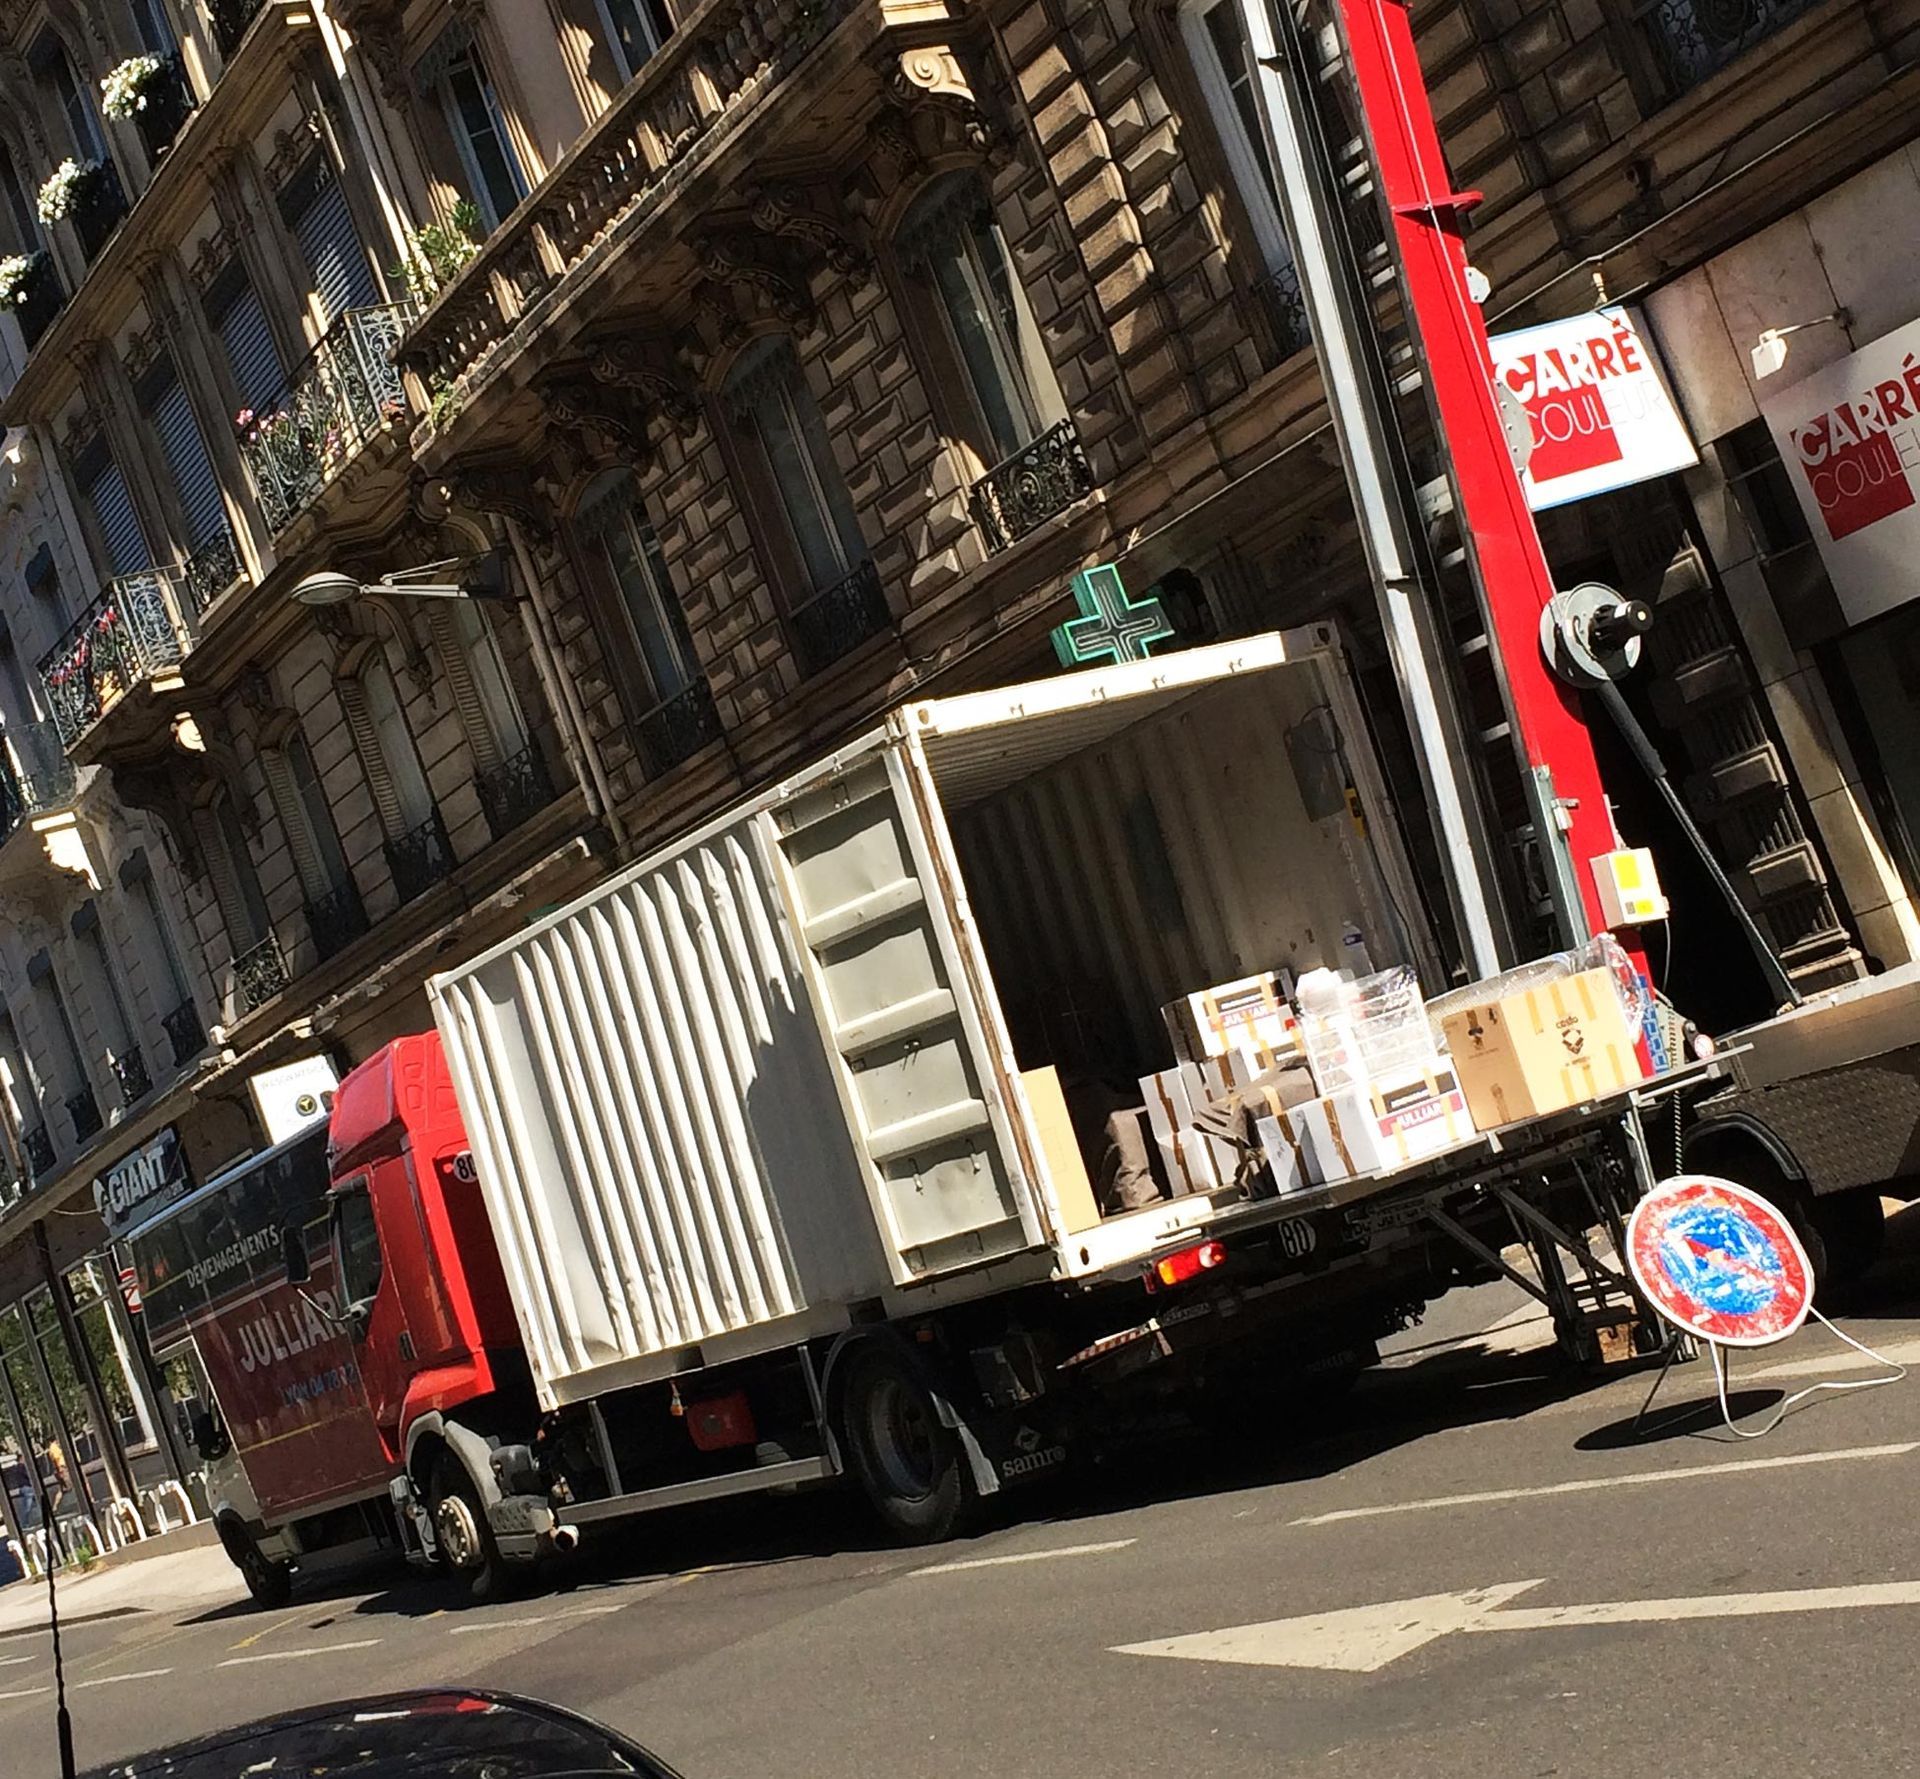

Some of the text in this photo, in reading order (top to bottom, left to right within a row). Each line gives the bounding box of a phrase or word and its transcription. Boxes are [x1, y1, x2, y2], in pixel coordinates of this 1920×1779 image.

[1495, 317, 1643, 403] CARRÉ
[1811, 427, 1920, 509] COULE
[108, 1146, 169, 1214] GIANT
[185, 1223, 281, 1288] DEMENAGEMENTS
[240, 1284, 346, 1373] JULLIAR
